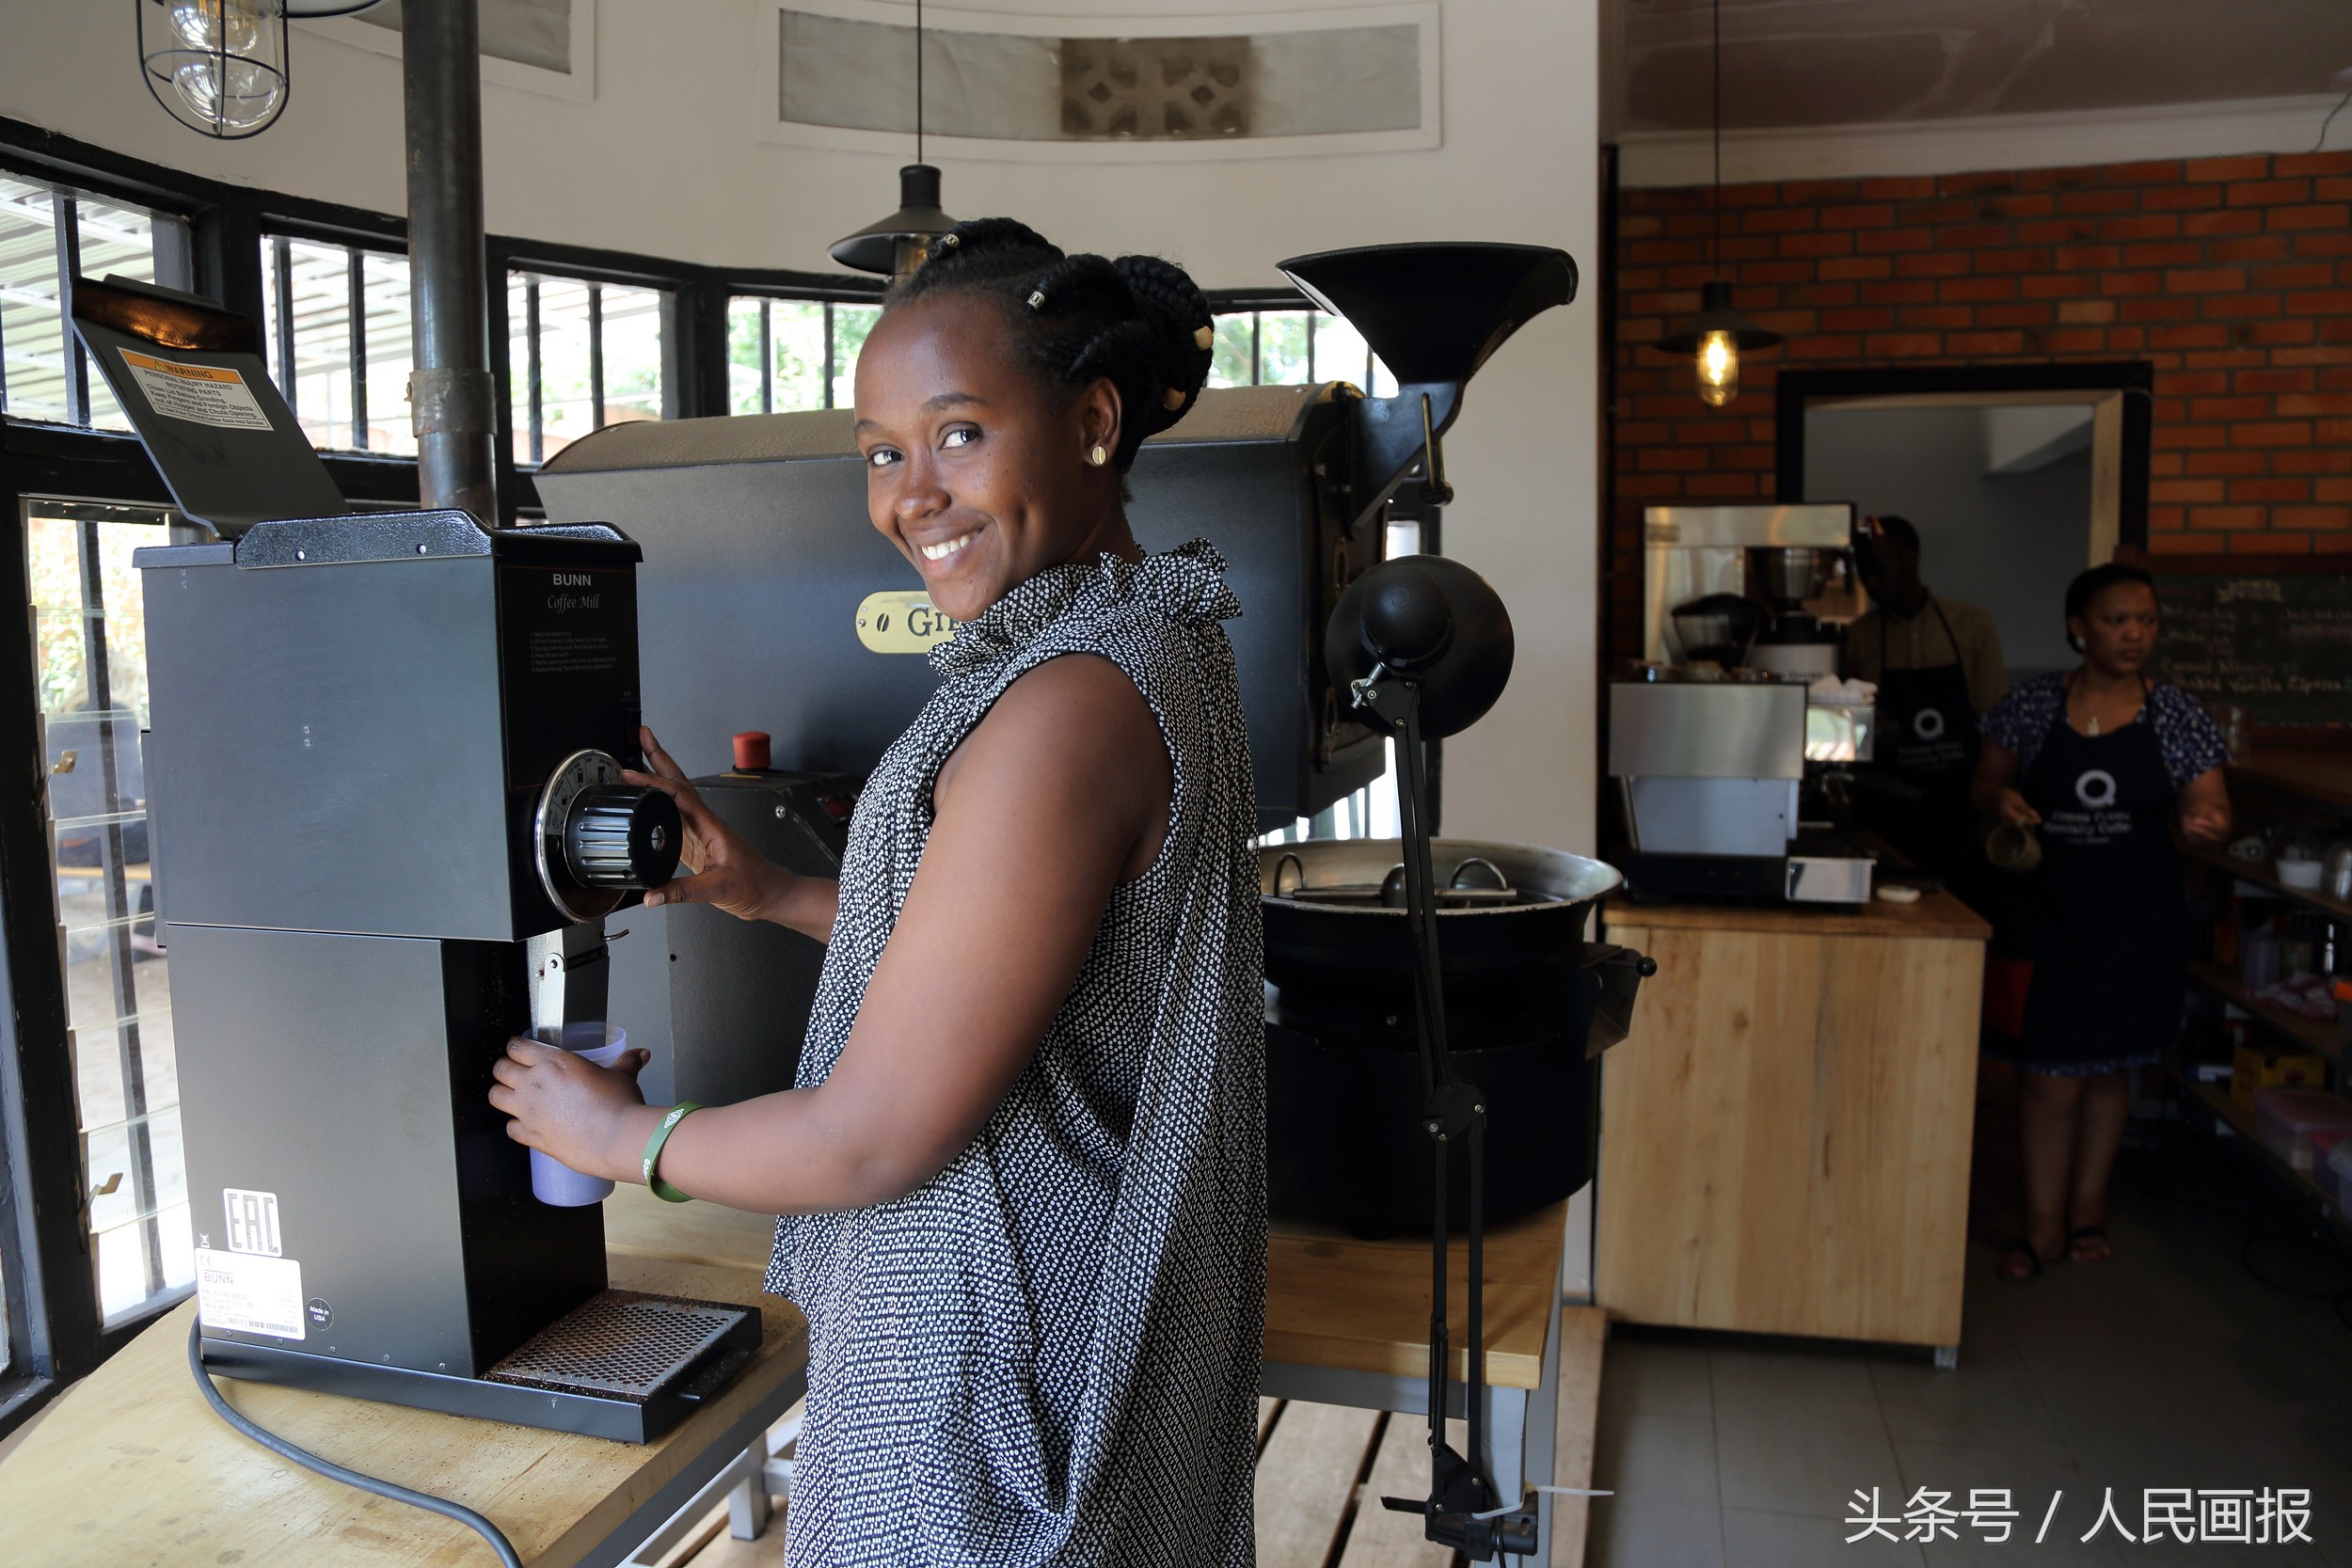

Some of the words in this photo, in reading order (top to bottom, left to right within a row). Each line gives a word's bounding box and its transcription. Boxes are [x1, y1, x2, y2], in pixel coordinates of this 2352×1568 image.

[144, 370, 180, 383] PERSONAL
[180, 378, 203, 388] INJURY
[164, 363, 214, 379] WARNING
[146, 384, 166, 392] Close
[176, 390, 197, 400] Before
[196, 395, 227, 404] Grinding.
[166, 382, 198, 394] ROTATING
[150, 390, 167, 399] Keep
[167, 394, 191, 404] Fingers
[203, 402, 229, 410] Foreign
[229, 404, 254, 412] Objects
[173, 403, 196, 411] Hopper
[228, 410, 258, 420] Opening.
[553, 573, 592, 587] BUNN
[548, 594, 577, 613] Coffee
[579, 594, 601, 609] Mill
[203, 1272, 233, 1285] BUNN
[310, 1306, 324, 1314] Made
[313, 1314, 326, 1323] USA
